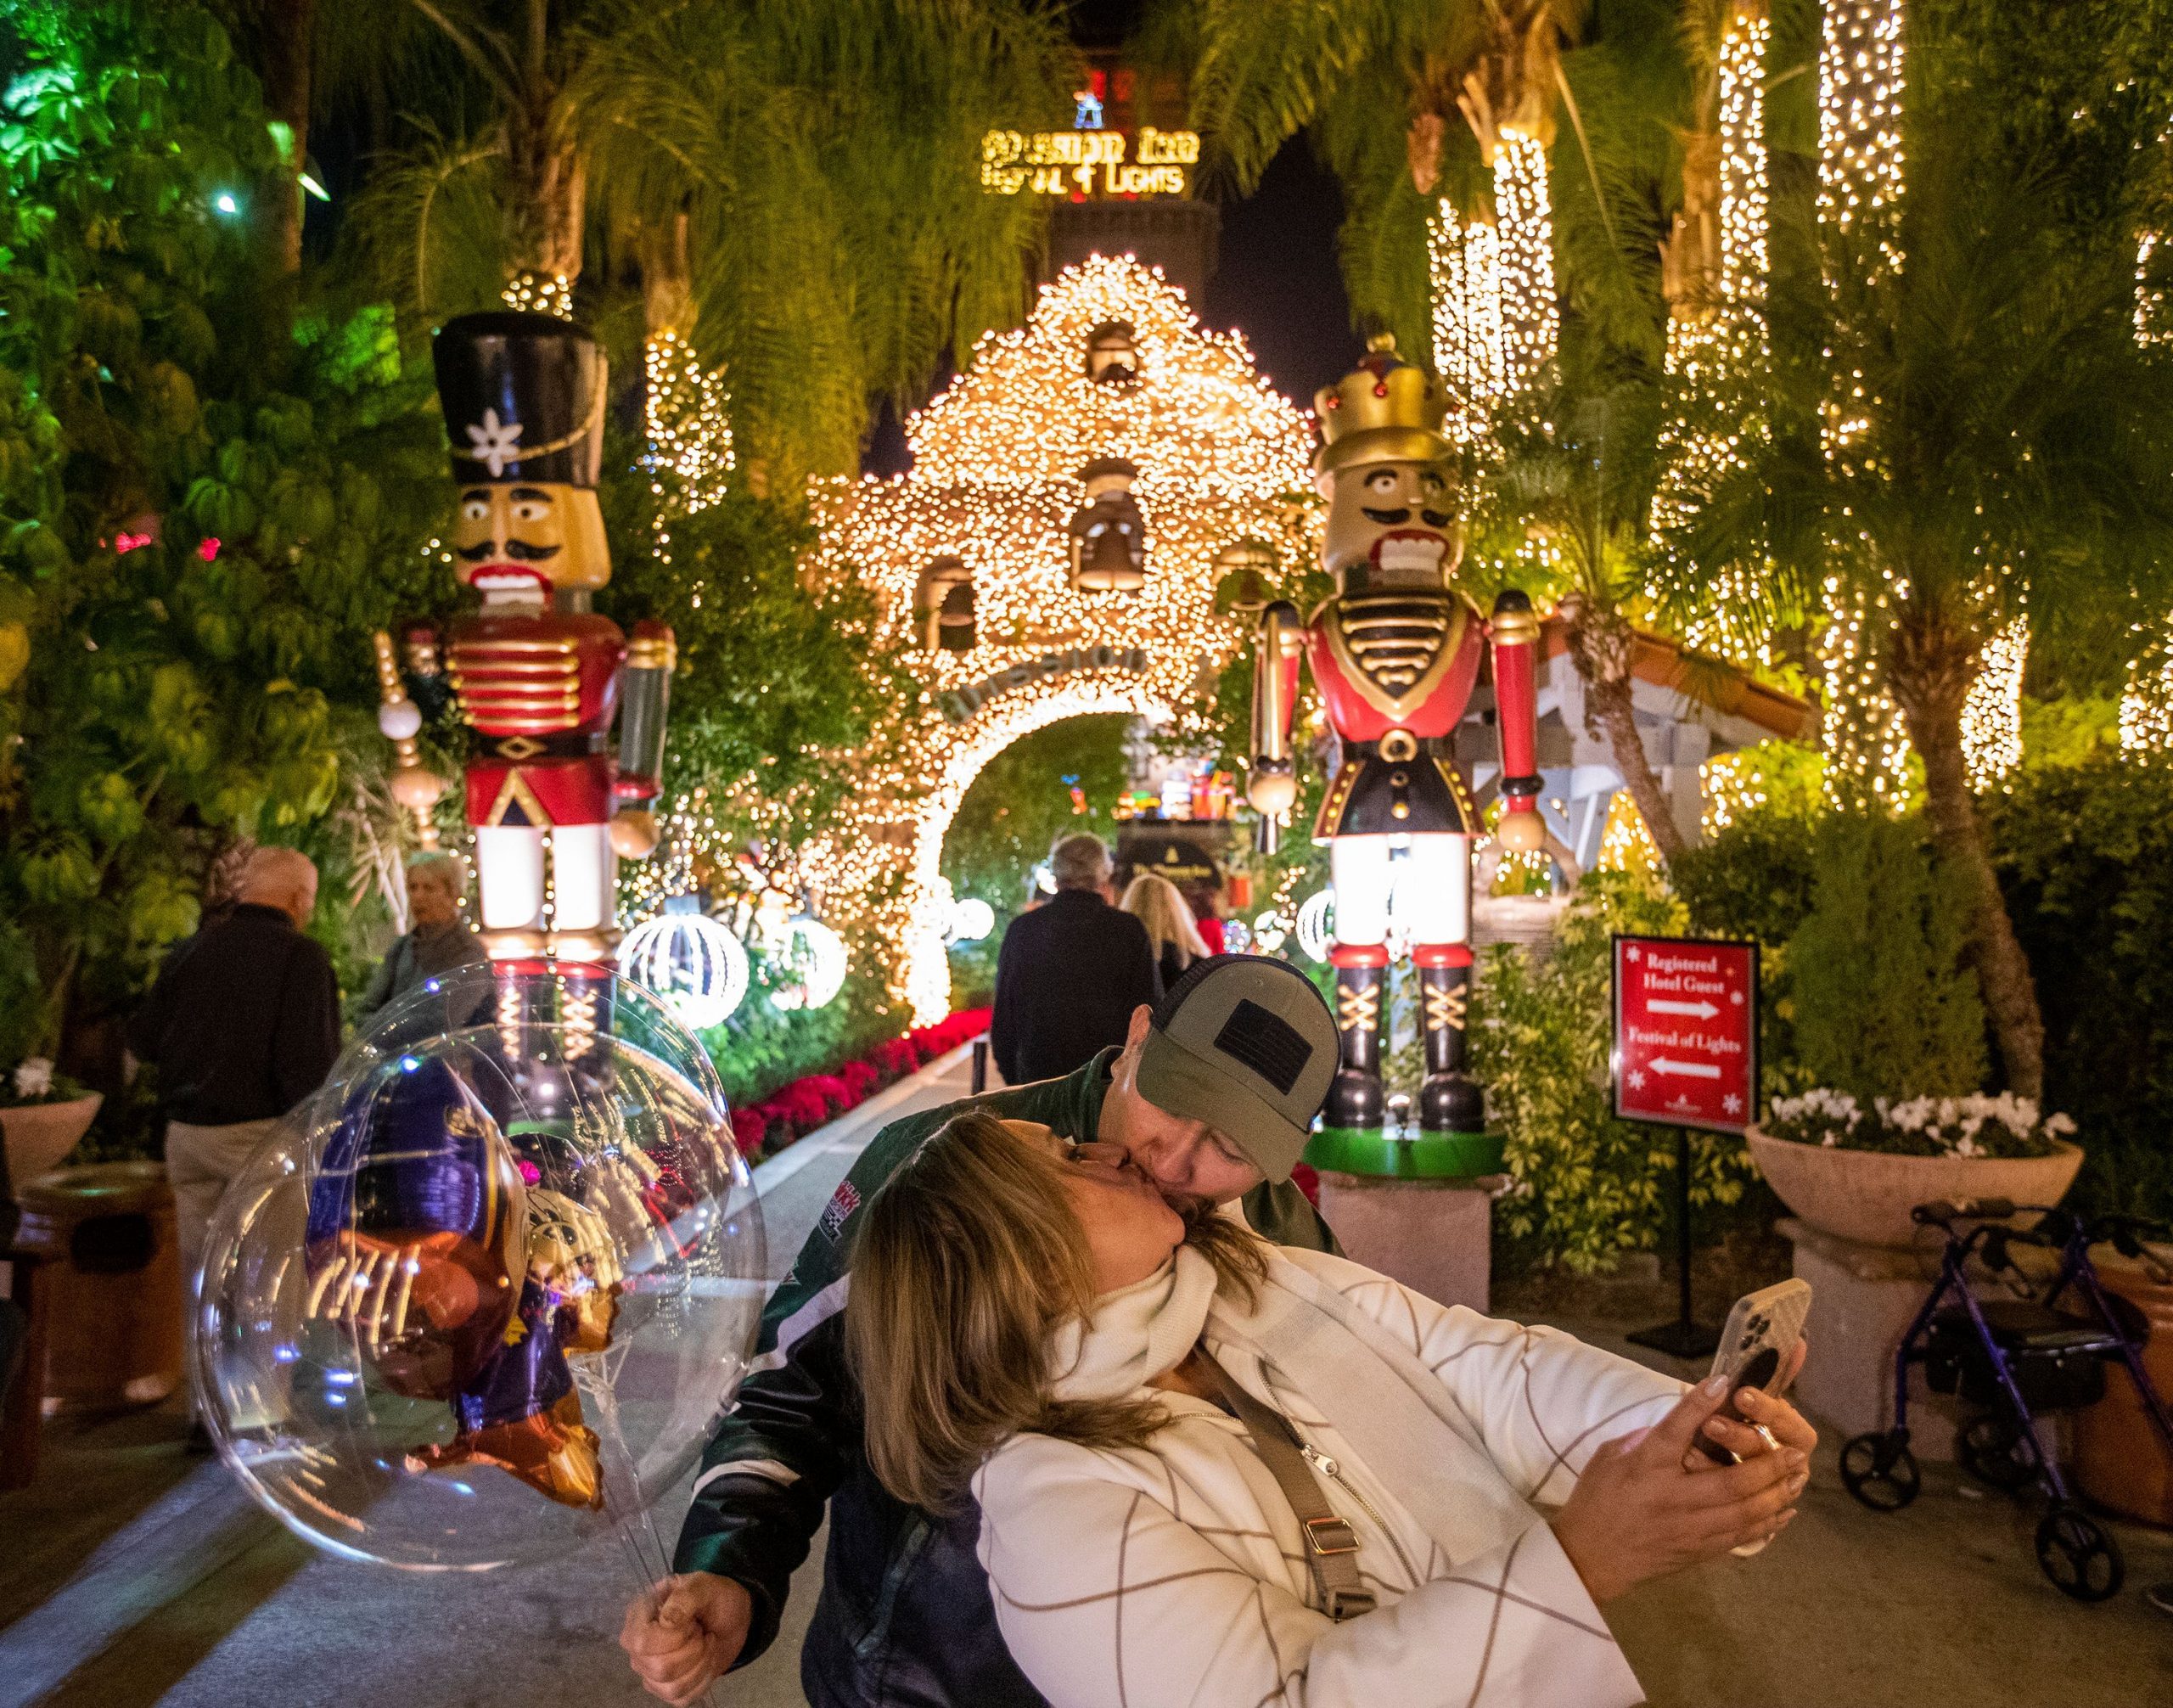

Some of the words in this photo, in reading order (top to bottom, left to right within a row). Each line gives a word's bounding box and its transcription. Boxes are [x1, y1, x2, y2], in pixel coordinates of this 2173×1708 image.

[1647, 952, 1718, 974] Registered
[1643, 973, 1681, 992] Hotel
[1683, 975, 1725, 994] Guest
[1628, 1026, 1678, 1047] Festival
[1680, 1032, 1697, 1048] of
[1697, 1033, 1741, 1055] Lights
